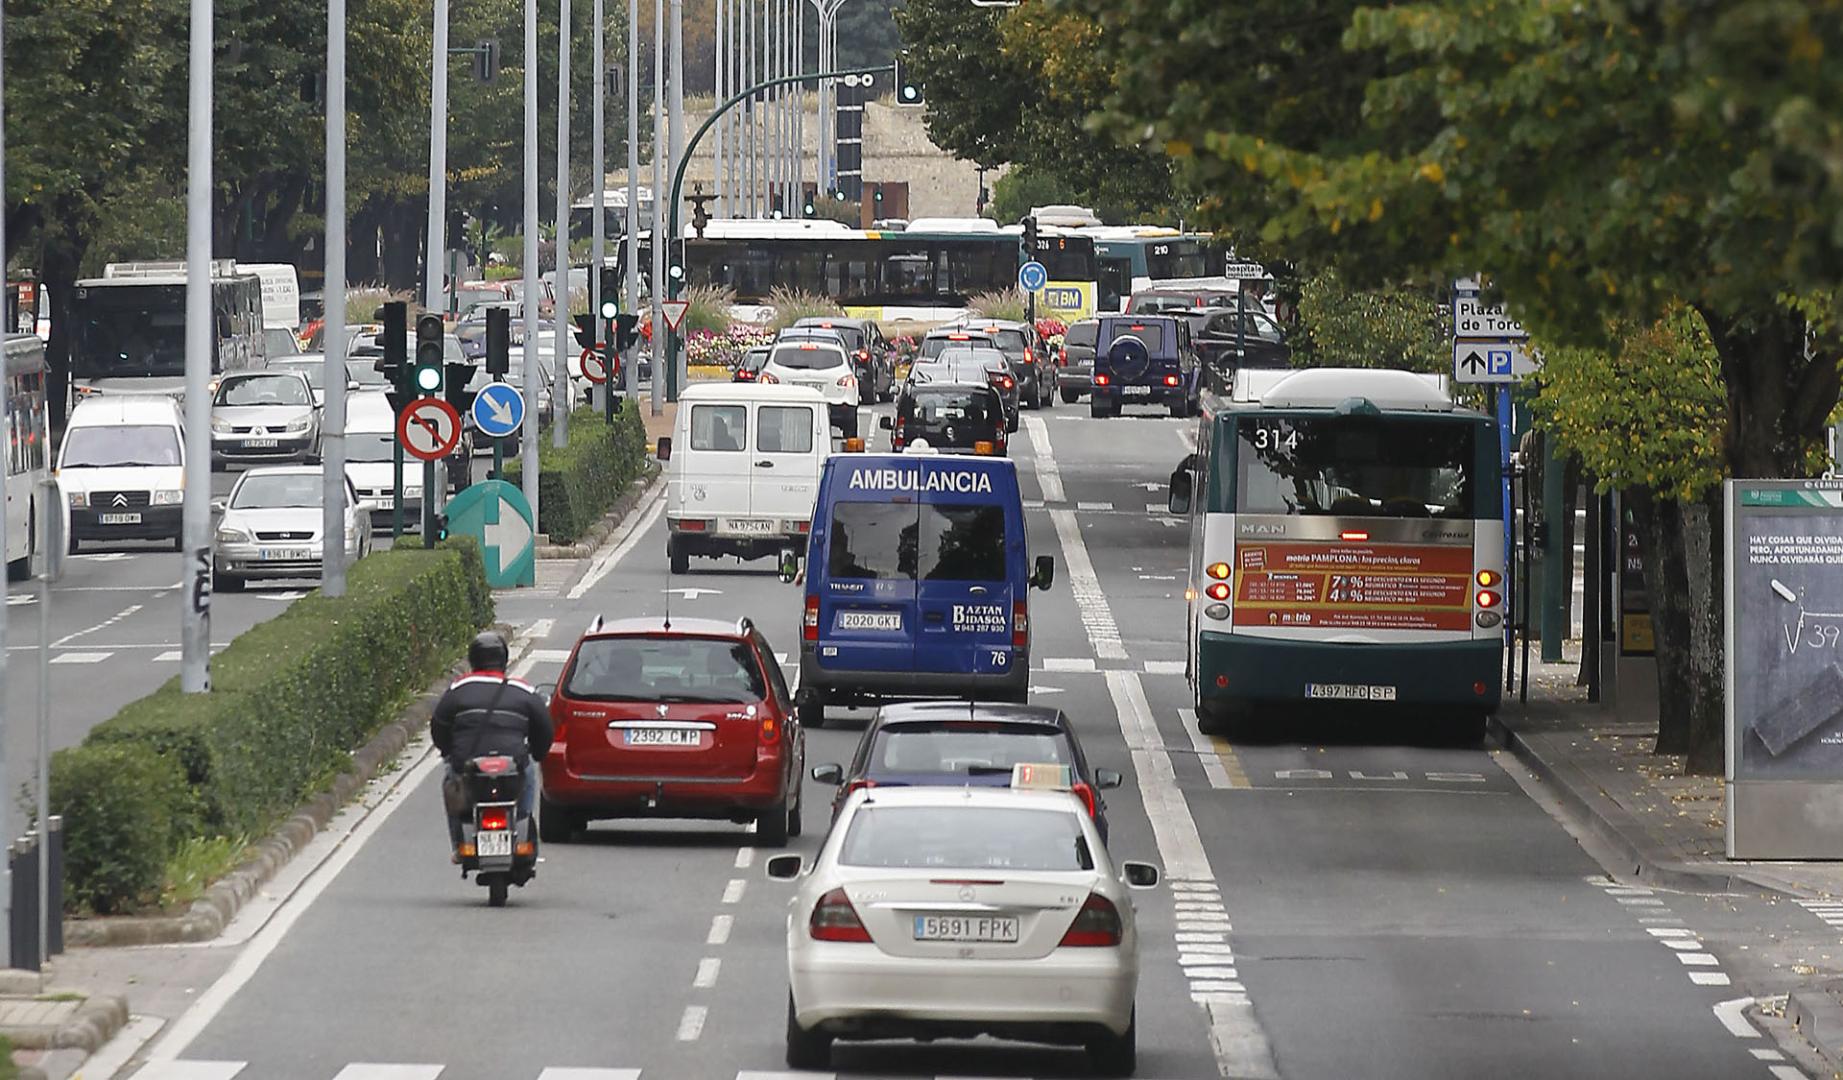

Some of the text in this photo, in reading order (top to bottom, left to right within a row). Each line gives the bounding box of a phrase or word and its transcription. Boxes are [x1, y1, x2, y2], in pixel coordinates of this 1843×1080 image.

[1460, 303, 1503, 315] Plaza
[1461, 319, 1480, 331] de
[1255, 429, 1298, 450] 314
[849, 469, 992, 493] AMBULANCIA
[1241, 525, 1286, 534] MAN
[1750, 536, 1767, 544] HAY
[1768, 536, 1794, 544] COSAS
[1796, 536, 1812, 544] QUE
[1750, 546, 1772, 555] PERO,
[1750, 556, 1778, 564] NUNCA
[846, 615, 899, 628] 2020 GKT
[991, 652, 1006, 666] 76
[1312, 684, 1340, 697] 4397
[632, 730, 698, 742] 2392 CWP
[927, 919, 1013, 936] 5691 FPK
